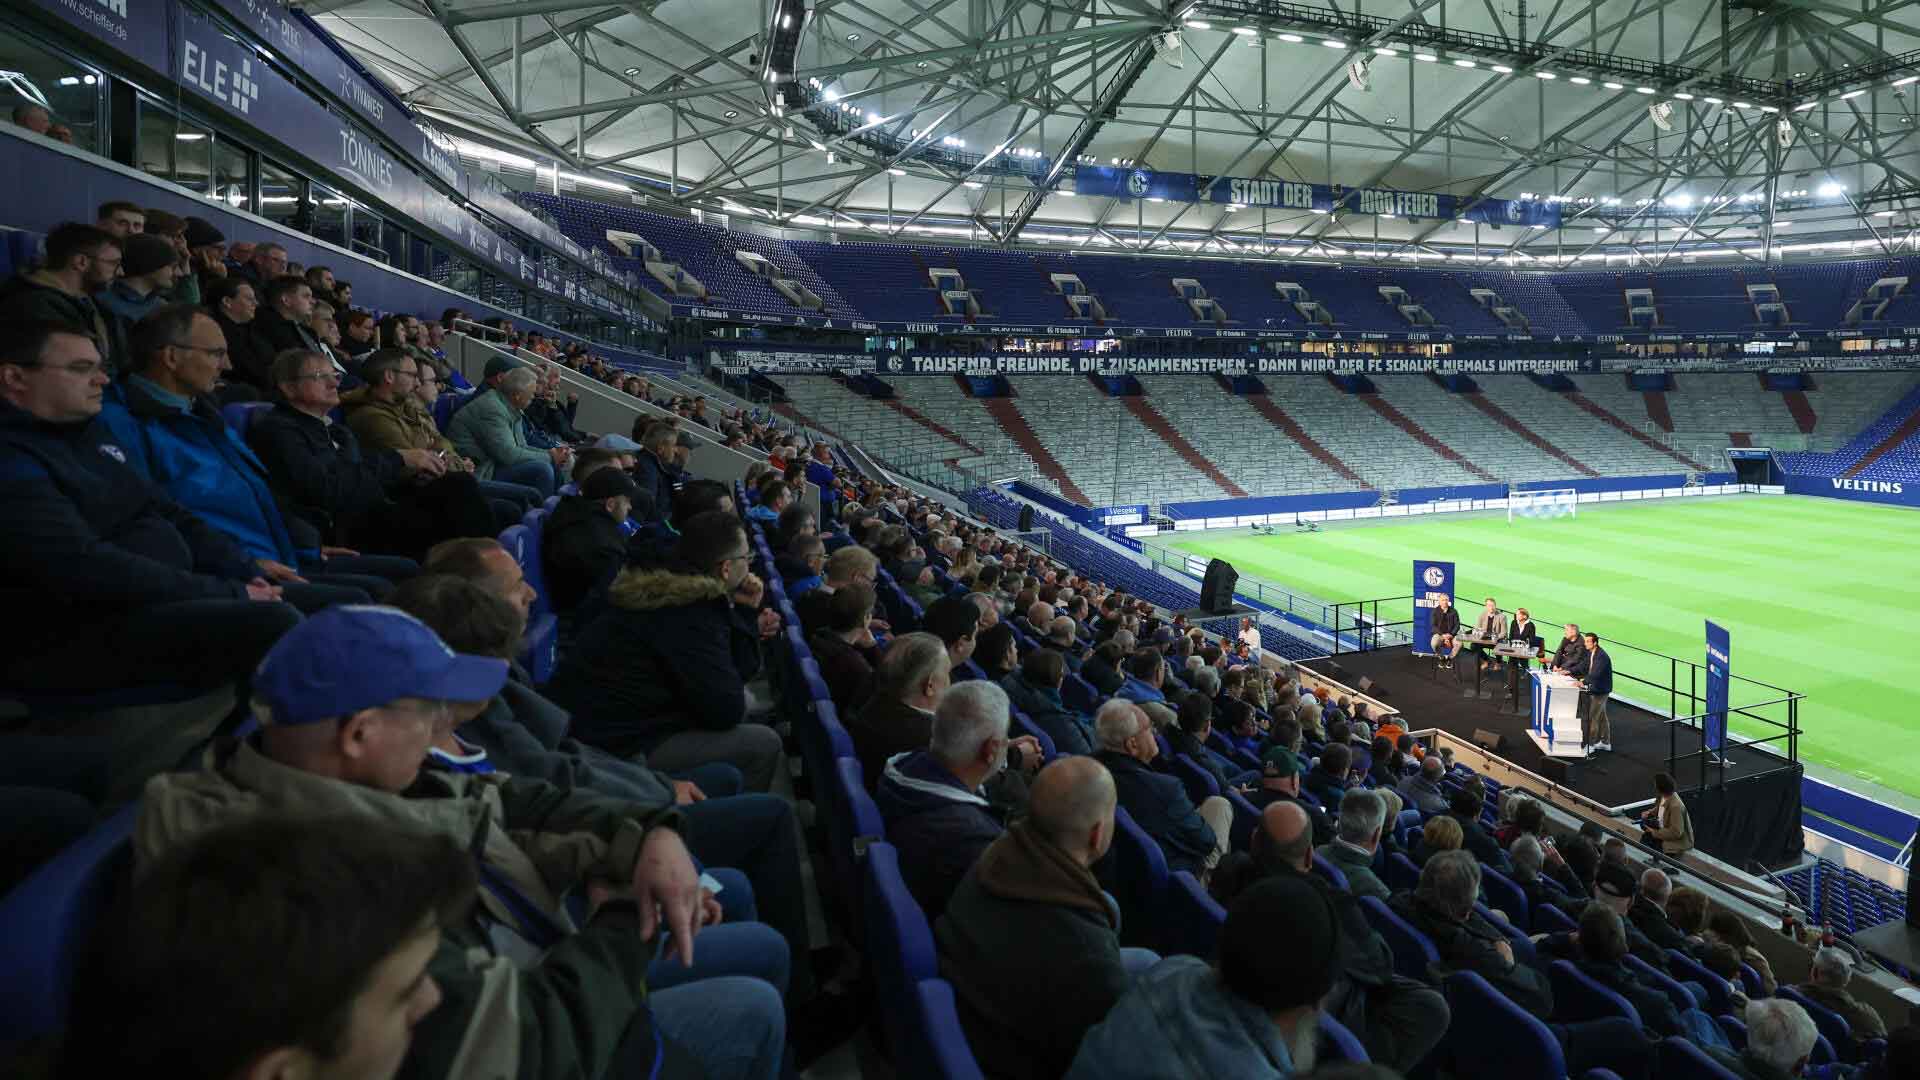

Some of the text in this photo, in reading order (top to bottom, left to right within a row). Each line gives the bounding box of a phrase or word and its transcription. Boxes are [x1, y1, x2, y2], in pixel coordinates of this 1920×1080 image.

[183, 40, 228, 102] ELE
[352, 79, 384, 122] VIVAWEST
[340, 128, 393, 187] TÖNNIES
[1231, 179, 1312, 209] STADT DER
[1397, 192, 1438, 217] FEUER
[906, 323, 939, 333] VELTINS
[1165, 329, 1193, 337] VELTINS
[911, 356, 992, 372] TAUSEND
[996, 356, 1075, 375] FREUNDE,
[1079, 357, 1105, 372] DIE
[1108, 357, 1246, 372] ZUSAMMENSTEHEN
[1258, 358, 1297, 372] DANN
[1301, 358, 1336, 372] WIRD
[1339, 358, 1365, 372] DER
[1368, 359, 1382, 372] FC
[1386, 359, 1440, 372] SCHALKE
[1443, 359, 1496, 372] NIEMALS
[1498, 359, 1579, 372] UNTERGEHEN!
[1832, 478, 1903, 494] VELTINS
